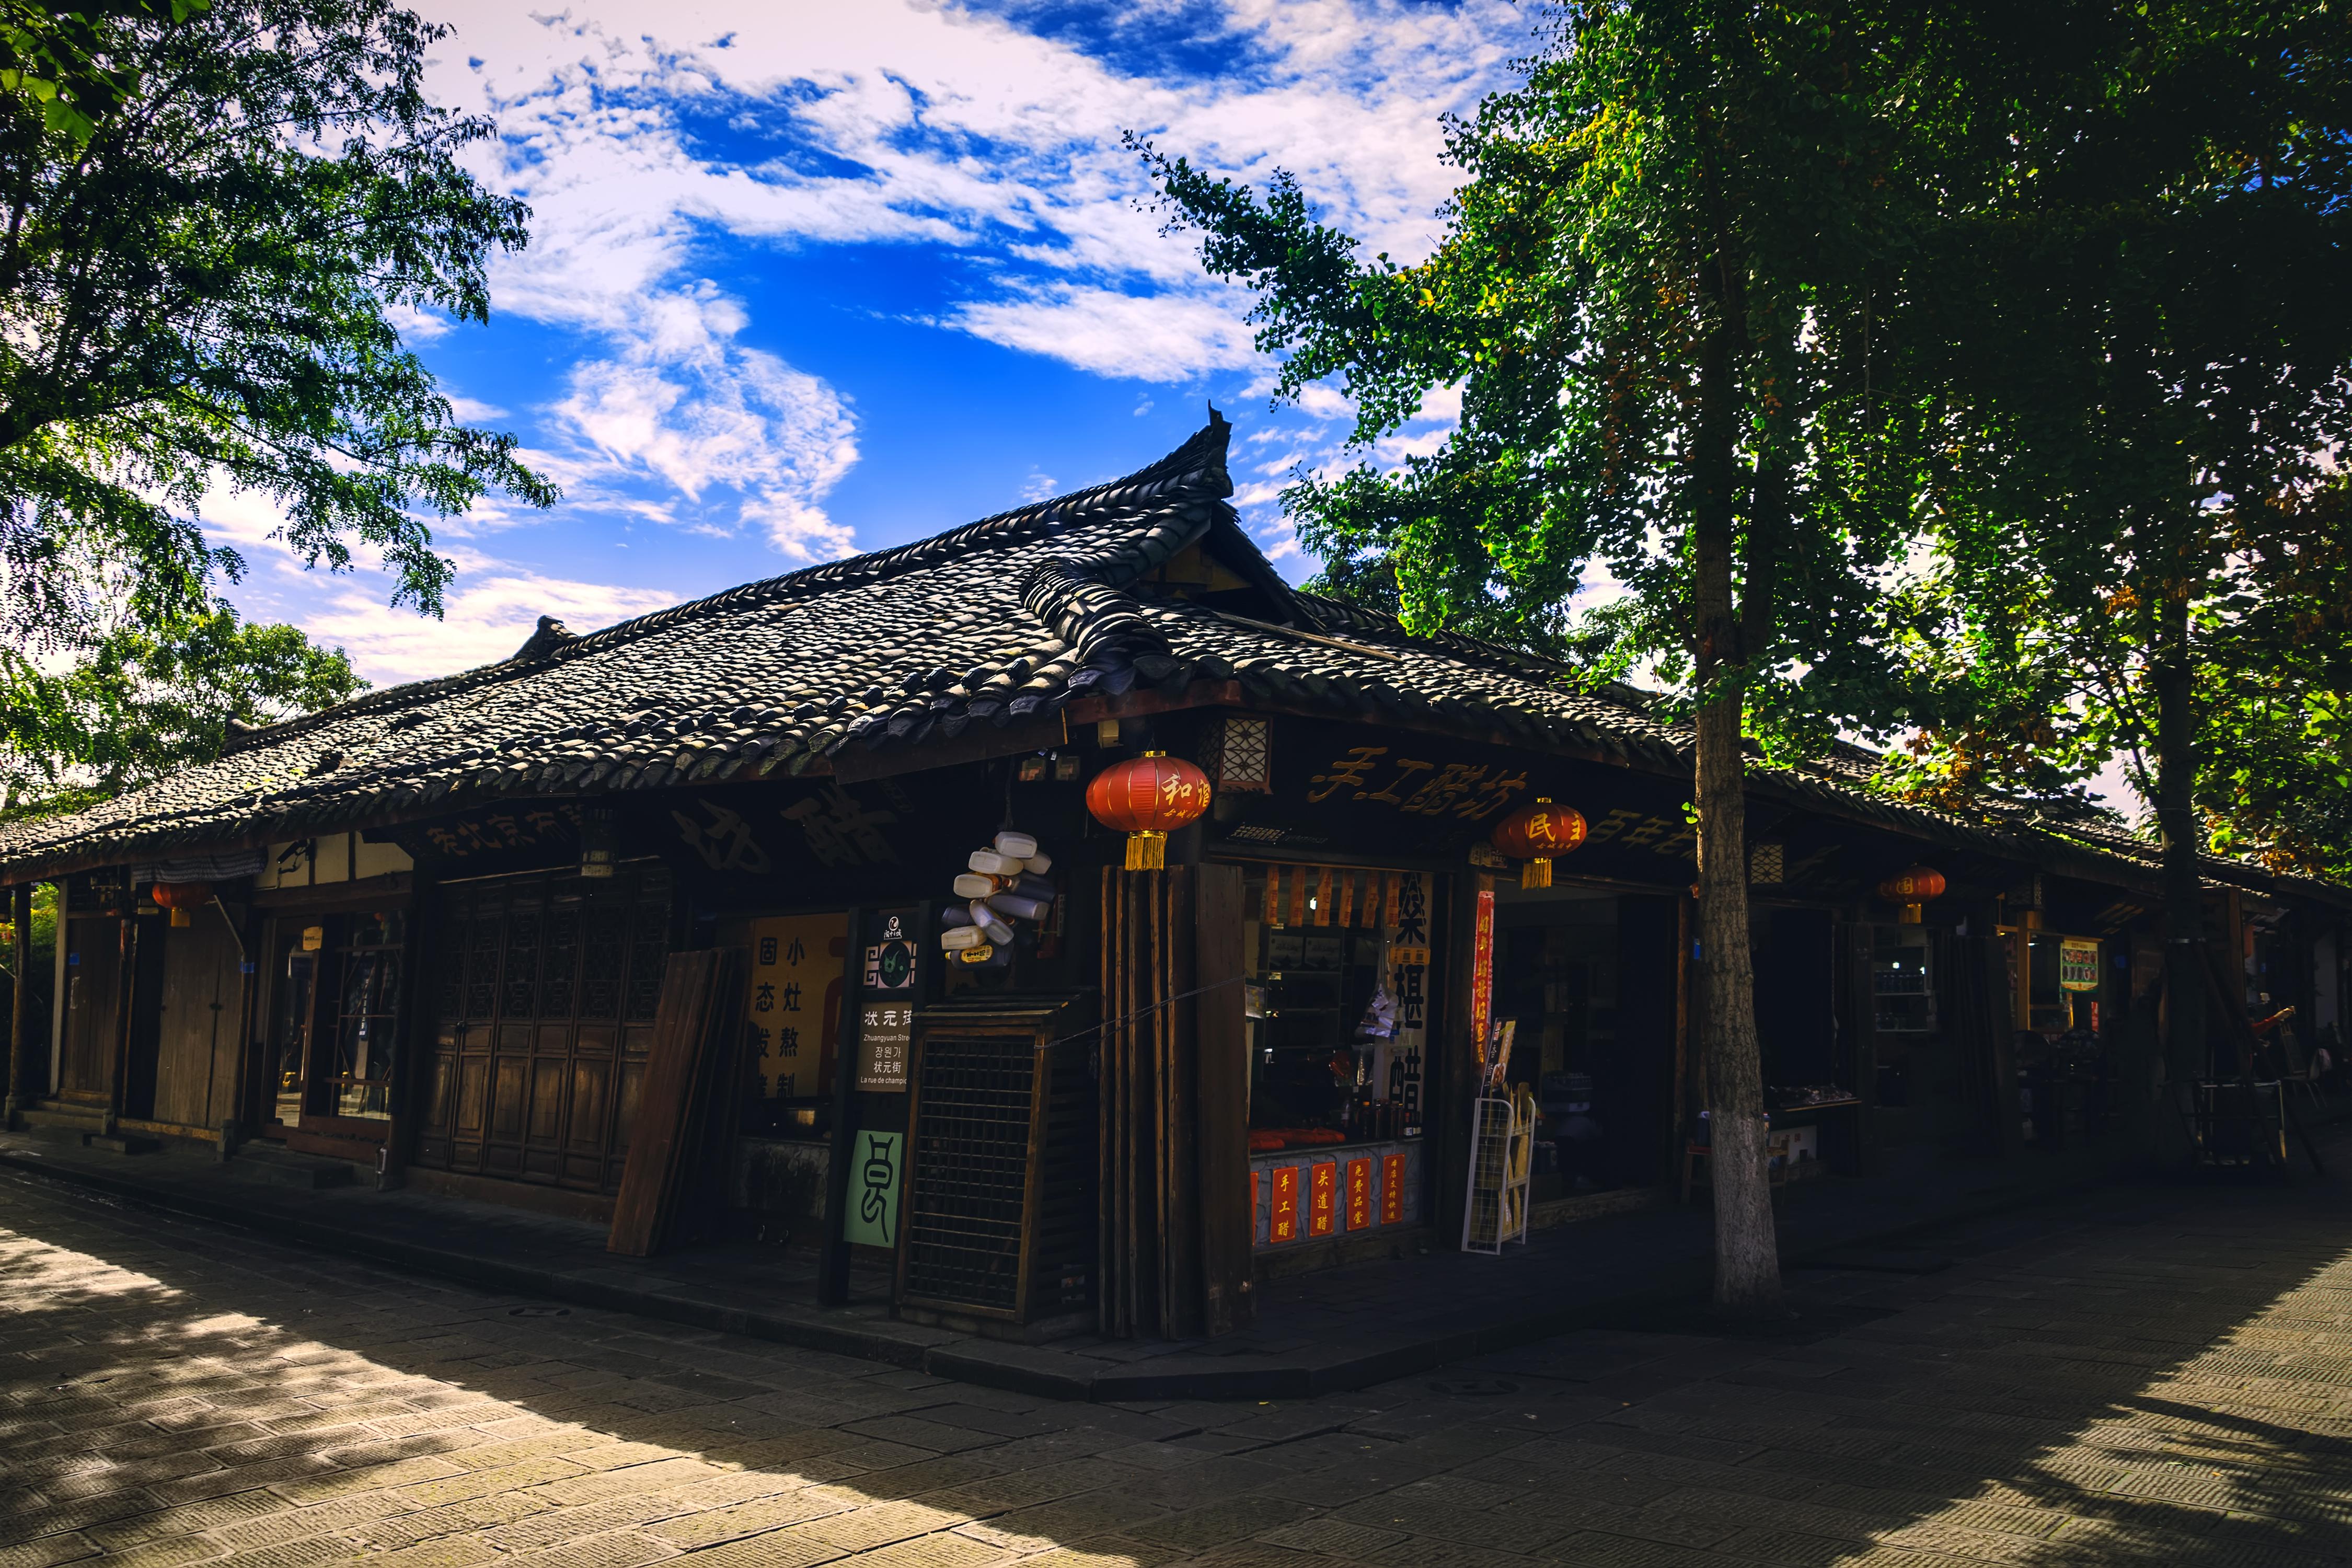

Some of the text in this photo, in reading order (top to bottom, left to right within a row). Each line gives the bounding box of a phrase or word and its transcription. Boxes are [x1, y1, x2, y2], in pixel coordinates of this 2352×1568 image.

[1161, 774, 1210, 807] 和谐
[1307, 746, 1528, 821] 手工醋坊
[1528, 812, 1580, 842] 民主
[863, 1033, 910, 1043] Zhuangyuan Stre
[875, 1046, 901, 1058] 장원가
[873, 1060, 901, 1074] 状元街
[1277, 1173, 1290, 1237] 手工醋
[1316, 1169, 1329, 1230] 头道醋
